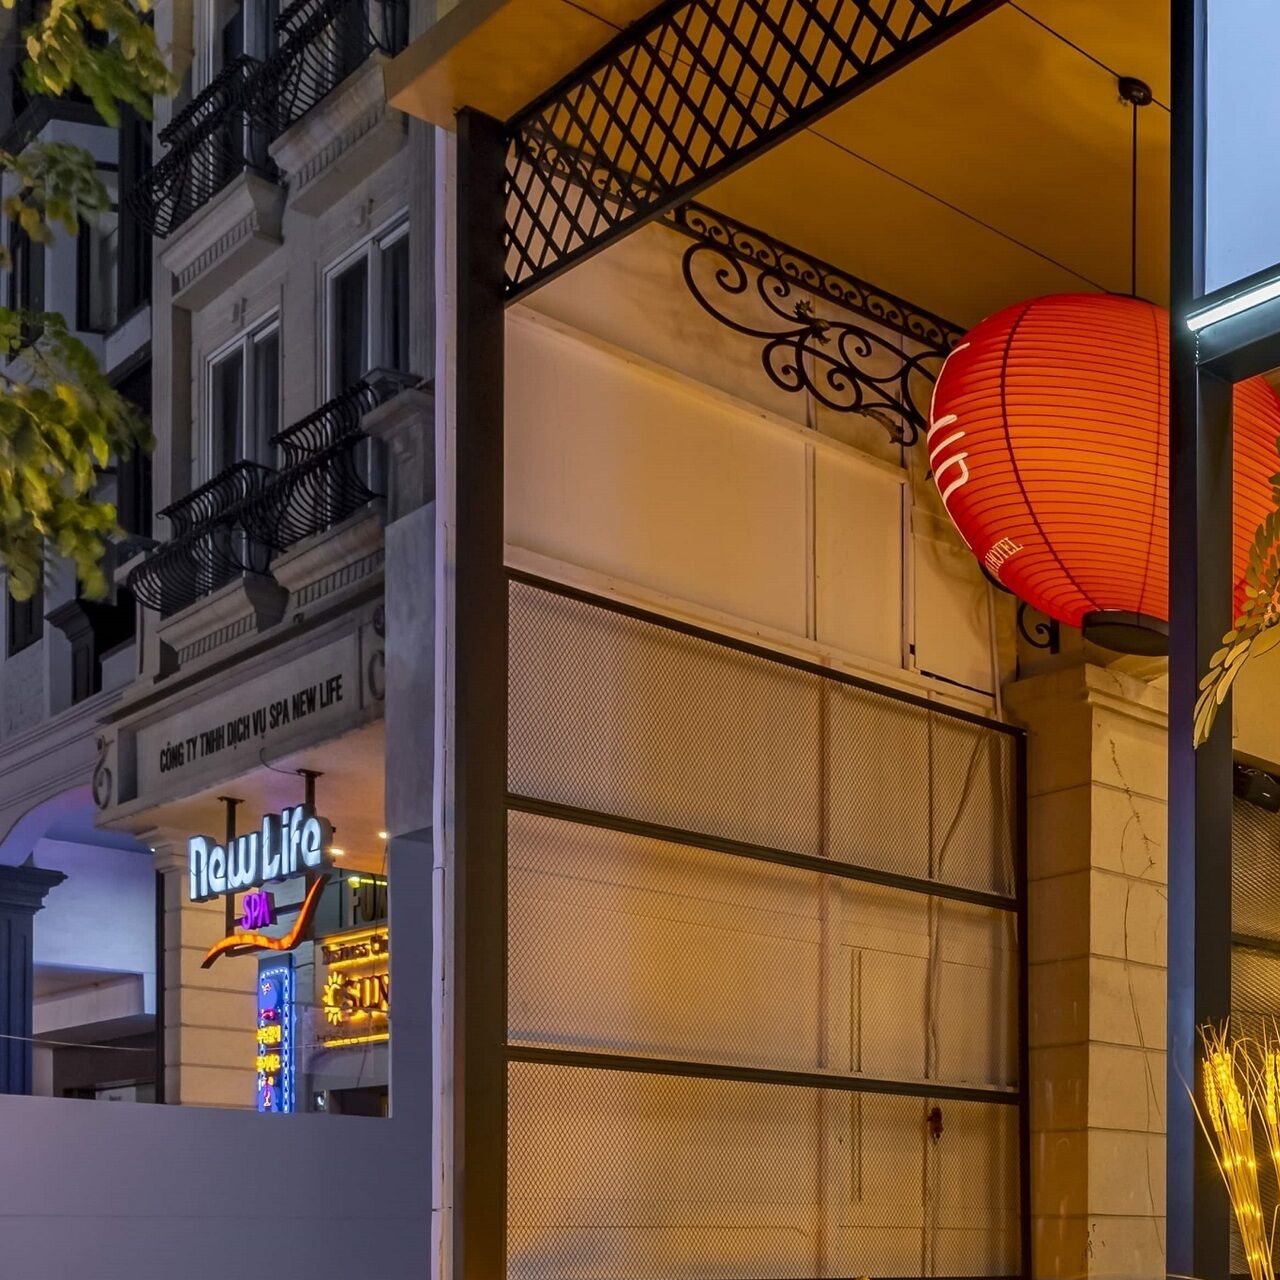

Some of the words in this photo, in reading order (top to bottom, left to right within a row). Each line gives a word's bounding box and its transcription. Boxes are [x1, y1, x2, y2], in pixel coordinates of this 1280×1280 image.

[160, 741, 184, 773] CÔNG
[186, 735, 197, 762] TY
[200, 725, 225, 757] TNHH
[227, 716, 250, 750] DỊCH
[252, 707, 267, 739] VỤ
[269, 698, 289, 729] SPA
[292, 686, 317, 720] NEW
[319, 674, 343, 708] LIFE
[262, 806, 321, 880] Life
[241, 891, 271, 931] SPA
